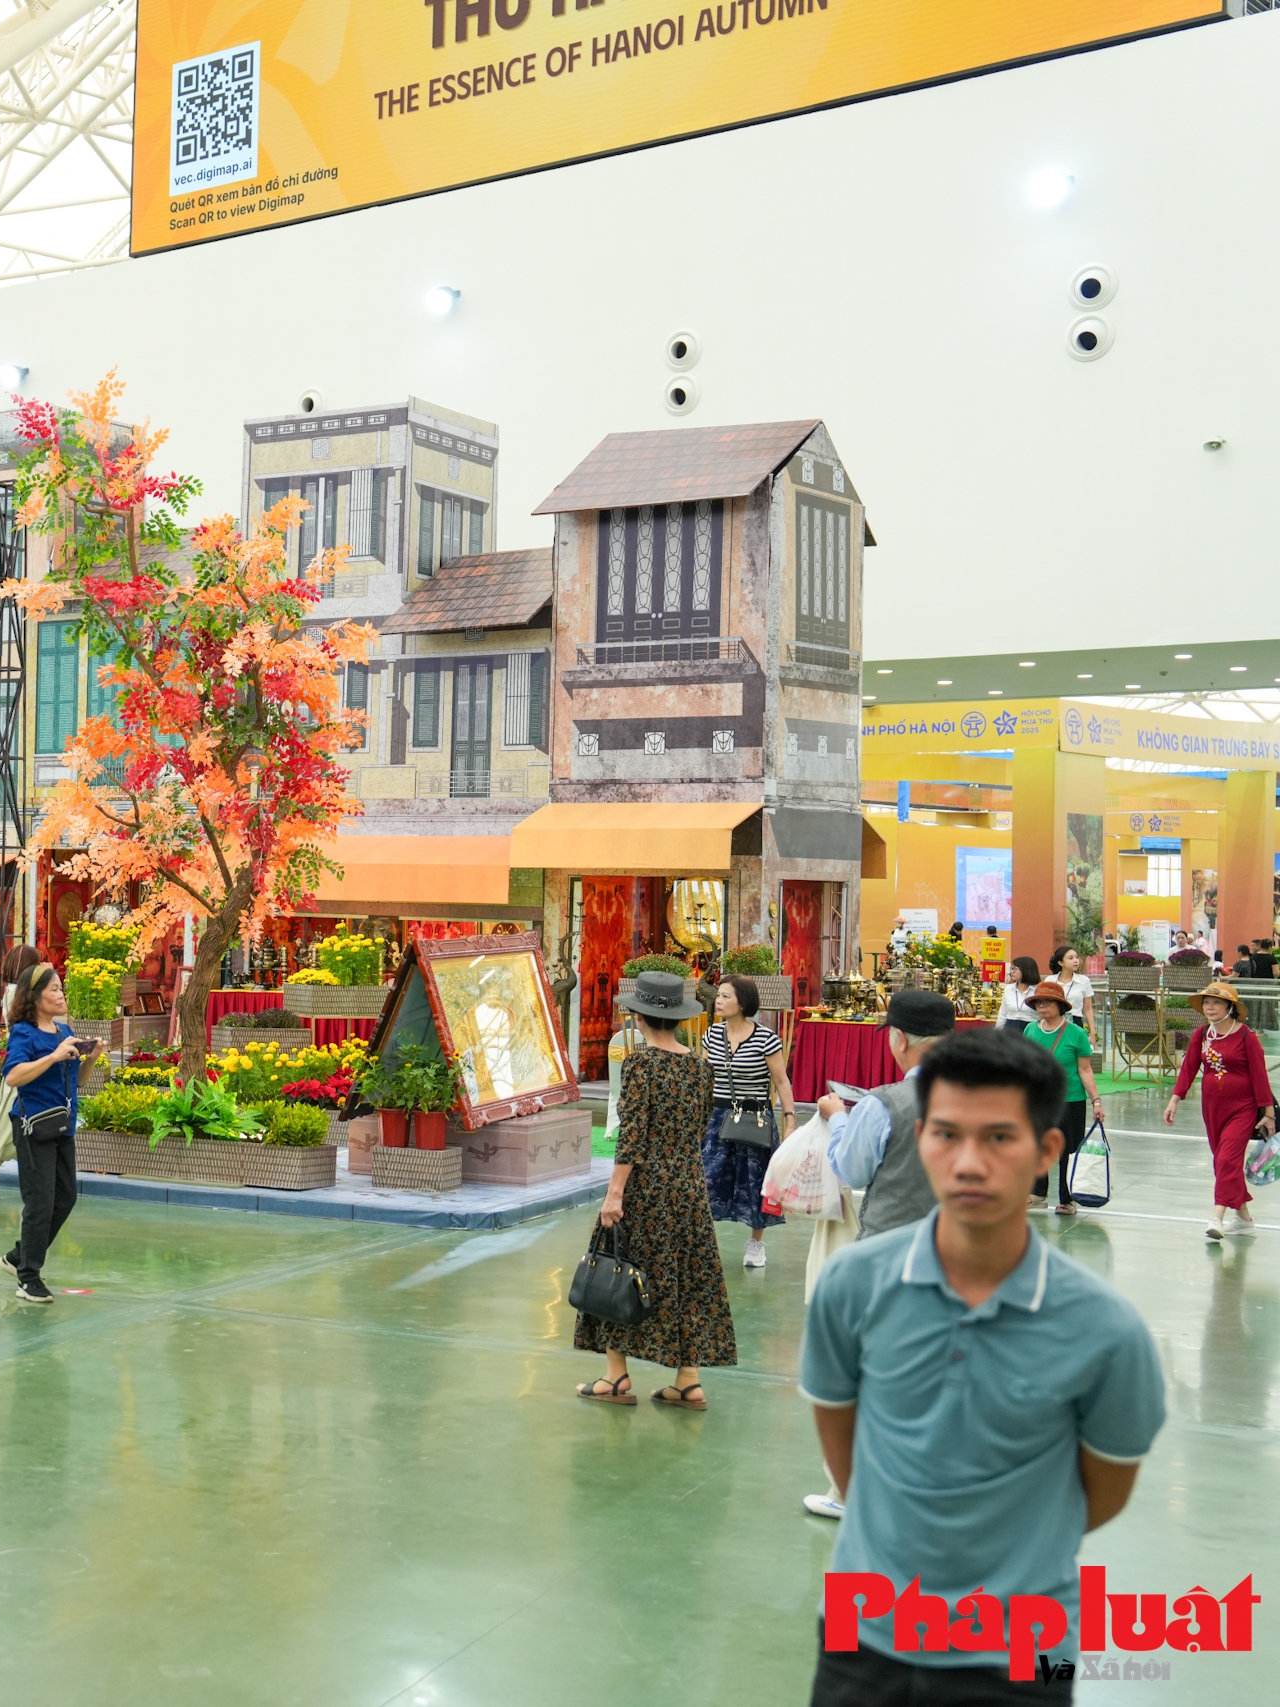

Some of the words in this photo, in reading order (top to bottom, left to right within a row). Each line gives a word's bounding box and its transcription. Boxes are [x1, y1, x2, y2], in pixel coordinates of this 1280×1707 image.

[374, 83, 419, 120] THE
[428, 53, 536, 107] ESSENCE
[545, 41, 582, 77] OF
[591, 15, 684, 67] HANOI
[169, 196, 195, 213] Quét
[198, 193, 214, 208] QR
[216, 189, 239, 203] xem
[241, 182, 262, 198] bản
[265, 175, 280, 192] đồ
[302, 166, 339, 184] đường
[174, 158, 253, 186] vec.digimap.ai
[169, 212, 196, 230] Scan
[198, 210, 214, 225] QR
[216, 207, 228, 220] to
[229, 201, 256, 217] view
[258, 192, 305, 212] Digimap
[879, 718, 906, 736] PHỐ
[910, 719, 928, 735] HÀ
[932, 718, 955, 736] NỘI
[1137, 727, 1179, 752] KHÔNG
[1181, 735, 1209, 754] GIAN
[1211, 737, 1248, 757] TRƯNG
[1251, 736, 1271, 759] BÀY
